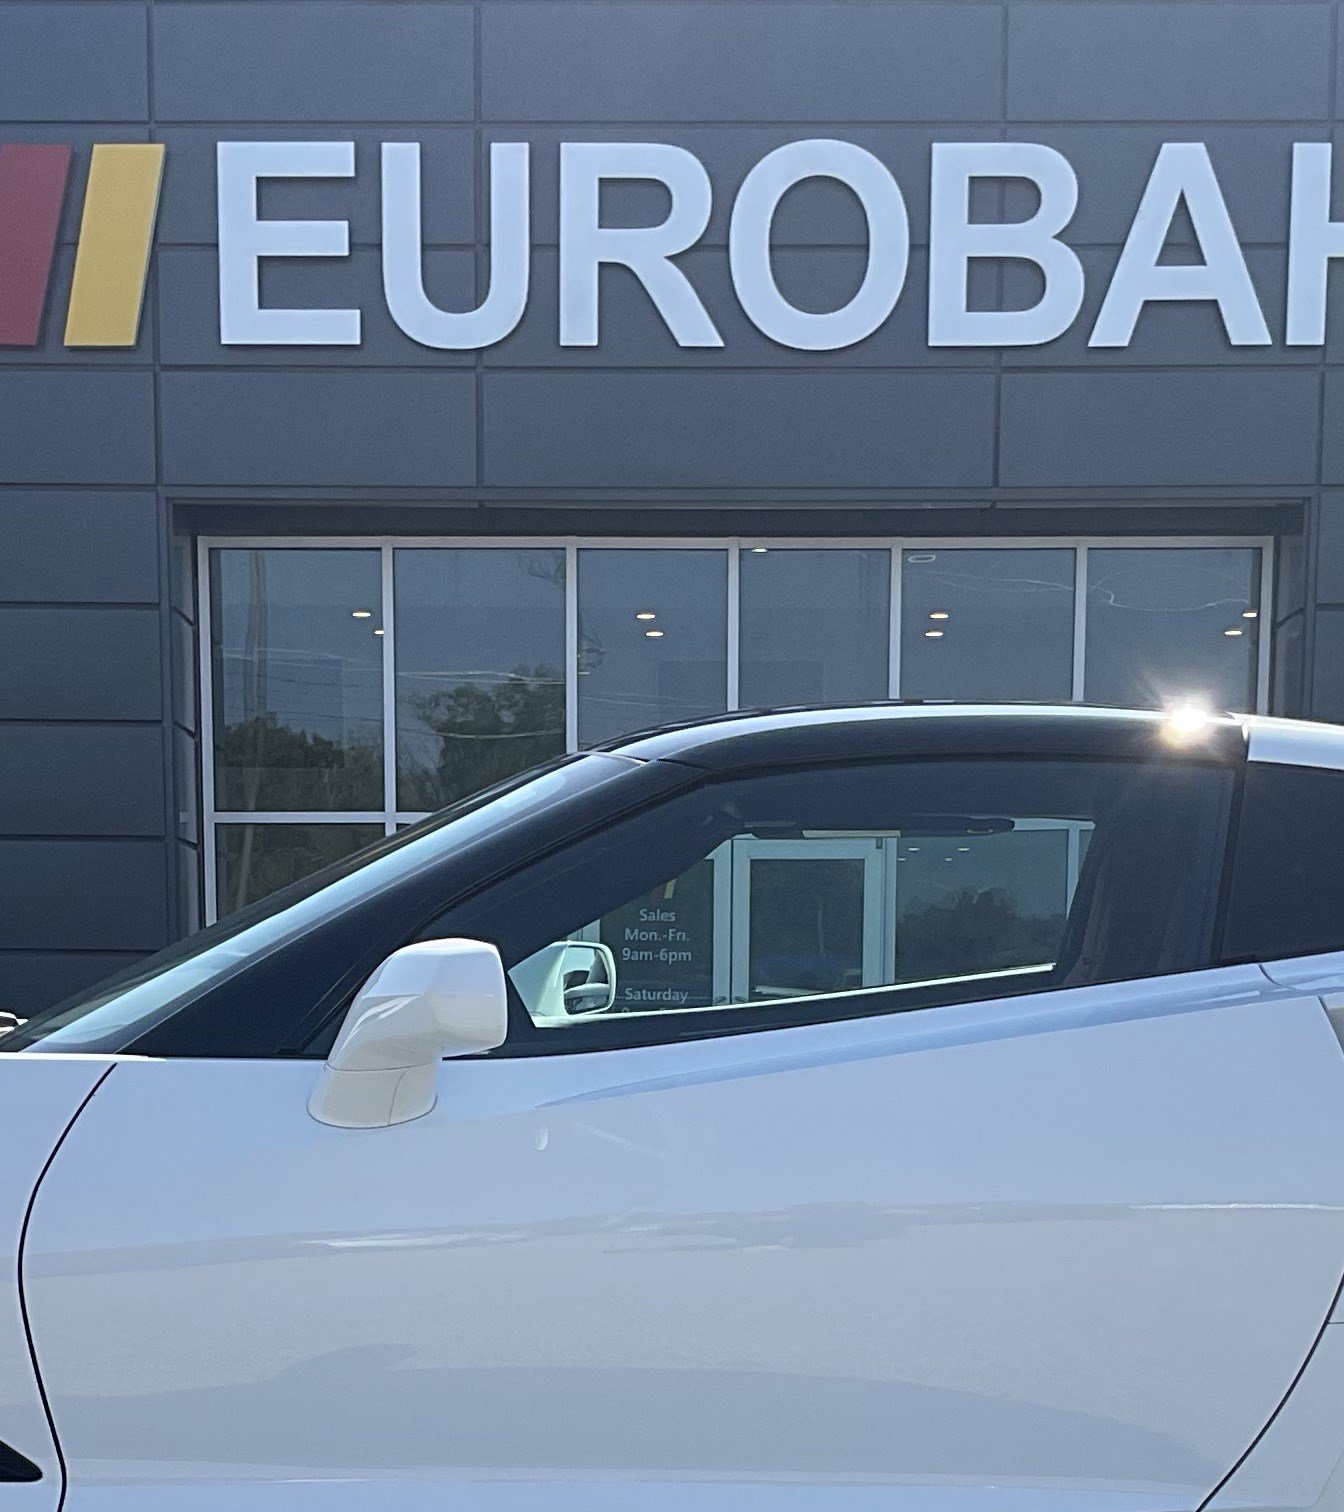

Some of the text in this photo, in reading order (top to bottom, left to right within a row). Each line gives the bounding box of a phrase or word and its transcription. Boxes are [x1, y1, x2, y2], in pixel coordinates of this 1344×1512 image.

[639, 908, 676, 922] Sales
[624, 928, 690, 941] Mon.-Fri.
[622, 947, 692, 965] 9am-6pm
[624, 987, 689, 1004] Saturday
